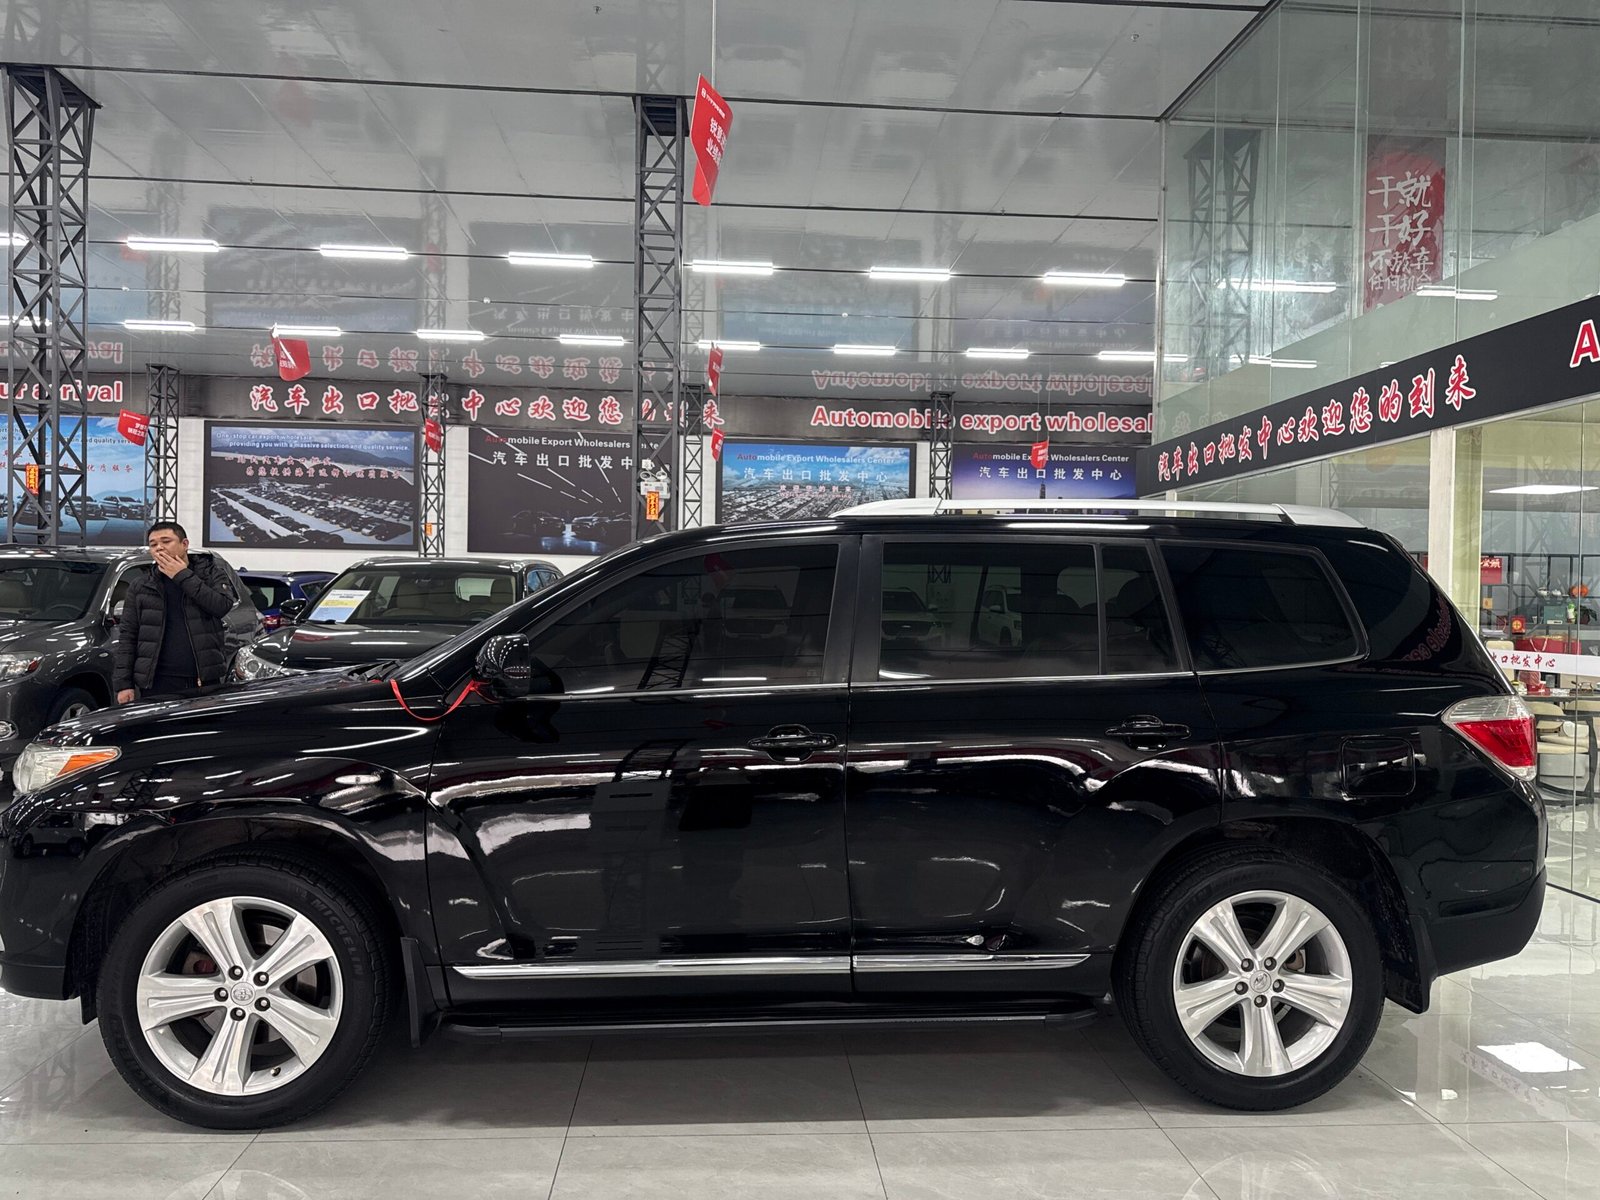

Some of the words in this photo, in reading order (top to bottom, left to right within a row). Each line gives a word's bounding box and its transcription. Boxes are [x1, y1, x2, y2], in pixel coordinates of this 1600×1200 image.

[1368, 246, 1434, 274] 不放弃
[1569, 319, 1600, 368] A
[32, 380, 122, 402] arival
[960, 412, 1041, 434] export
[1157, 354, 1477, 482] 汽车出口批发中心欢迎您的到来
[541, 436, 573, 448] Export
[574, 438, 631, 449] Wholesalers
[737, 453, 785, 462] Automobile
[787, 454, 814, 463] Export
[815, 455, 865, 464] Wholesalers
[867, 456, 894, 464] Center
[973, 451, 1020, 461] Automobile
[1050, 453, 1100, 462] Wholesalers
[1101, 454, 1129, 462] Center
[743, 468, 888, 483] 汽车出口批发中心
[979, 466, 1122, 480] 汽车出口批发中心
